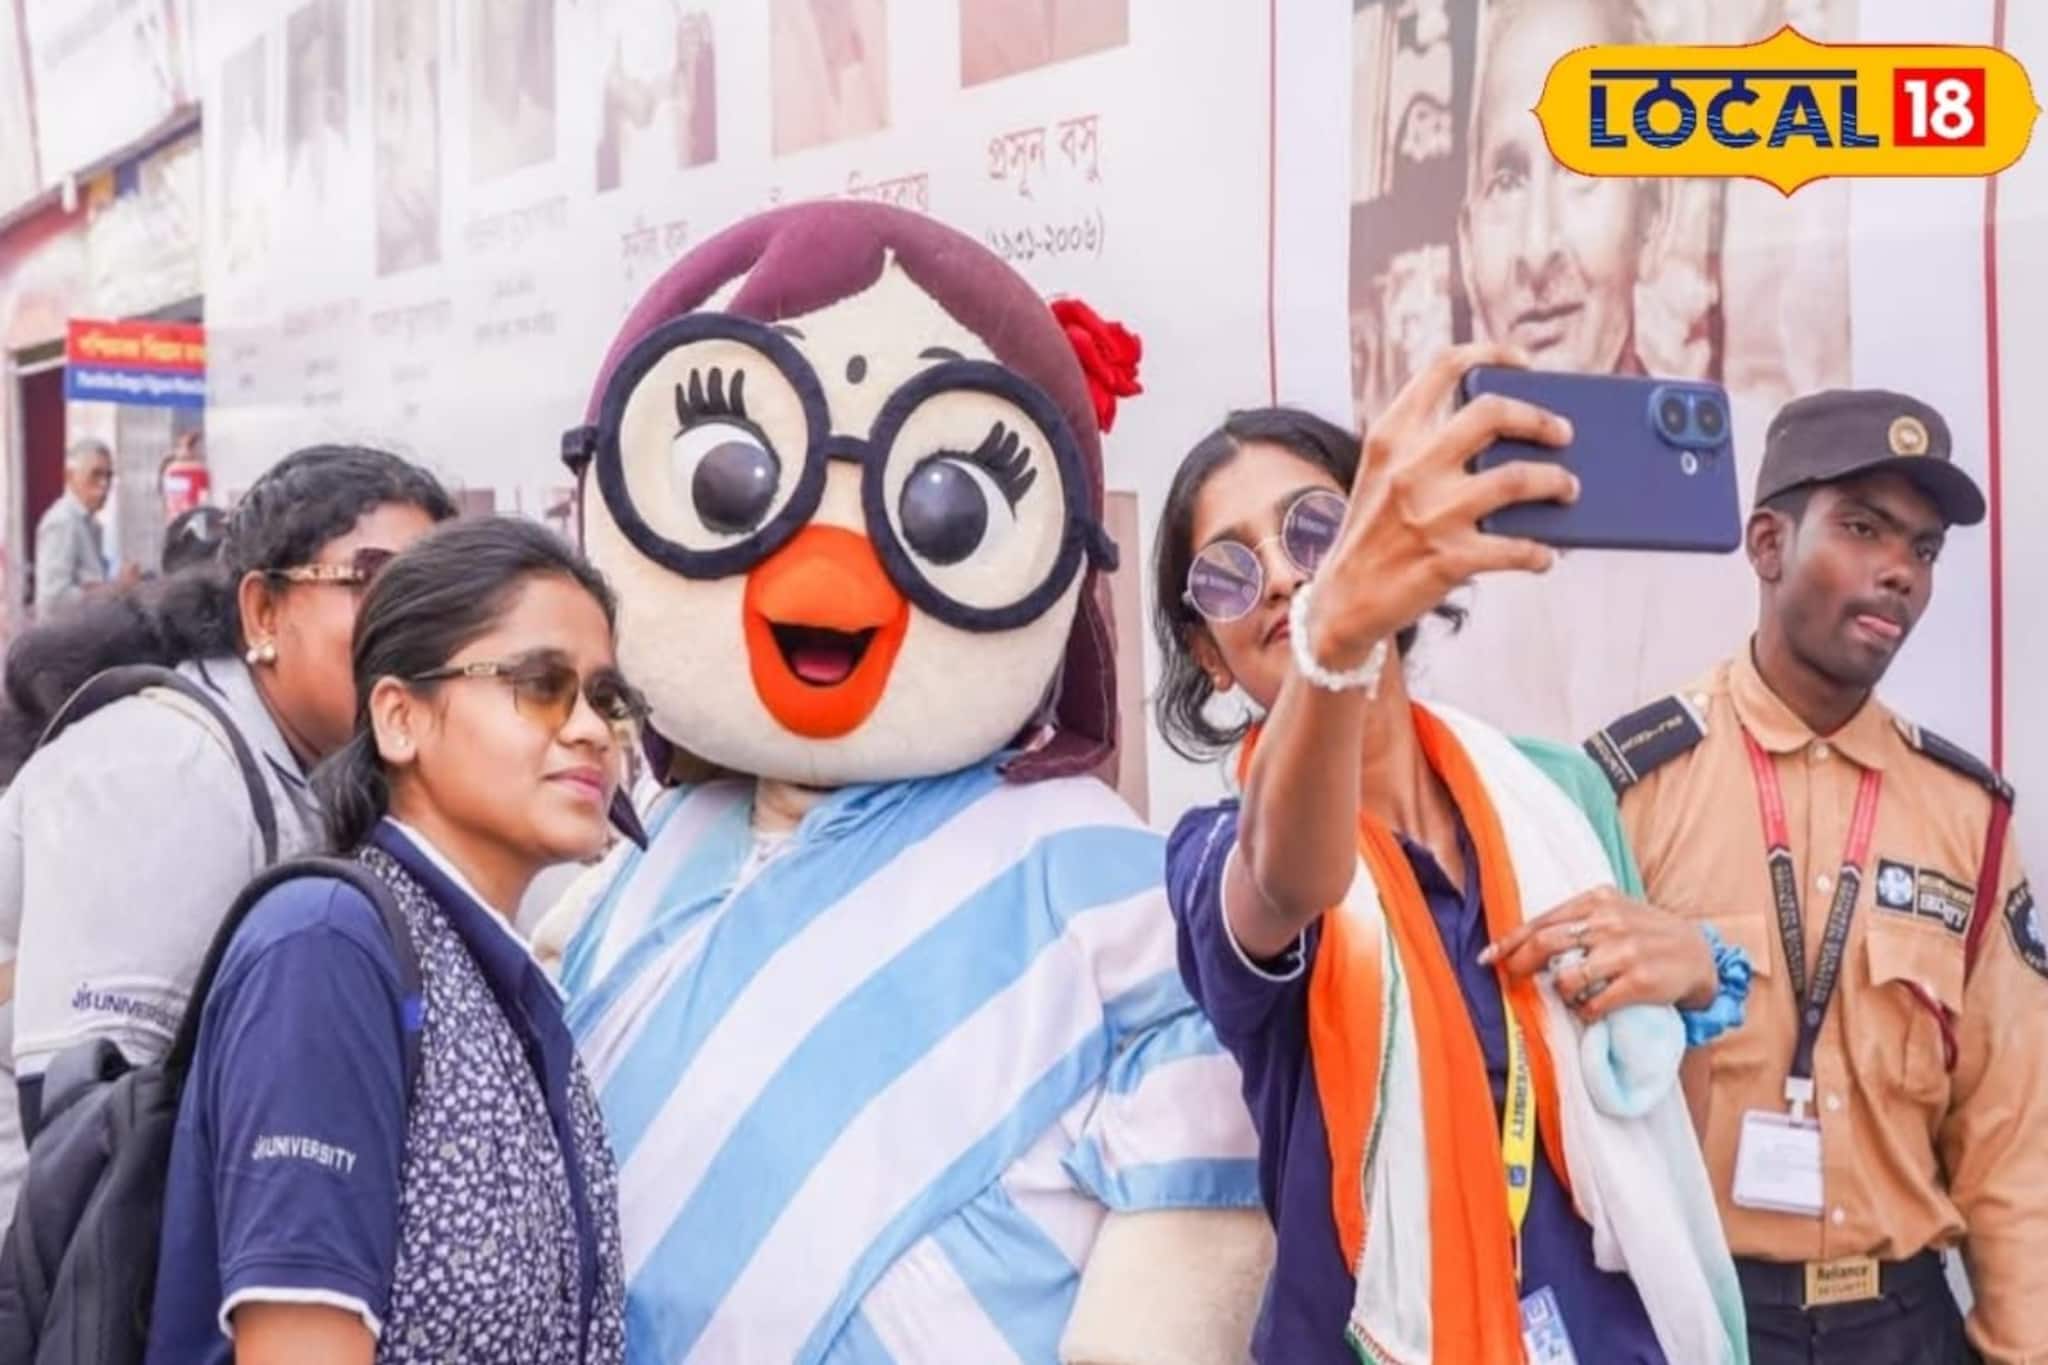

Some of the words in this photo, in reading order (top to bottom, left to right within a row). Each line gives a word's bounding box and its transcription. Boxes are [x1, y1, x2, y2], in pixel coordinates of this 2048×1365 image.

[1058, 113, 1102, 183] বসু
[94, 993, 178, 1027] UNIVERSI
[1512, 1031, 1528, 1139] IVERSITY
[264, 1135, 357, 1174] UNIVERSITY
